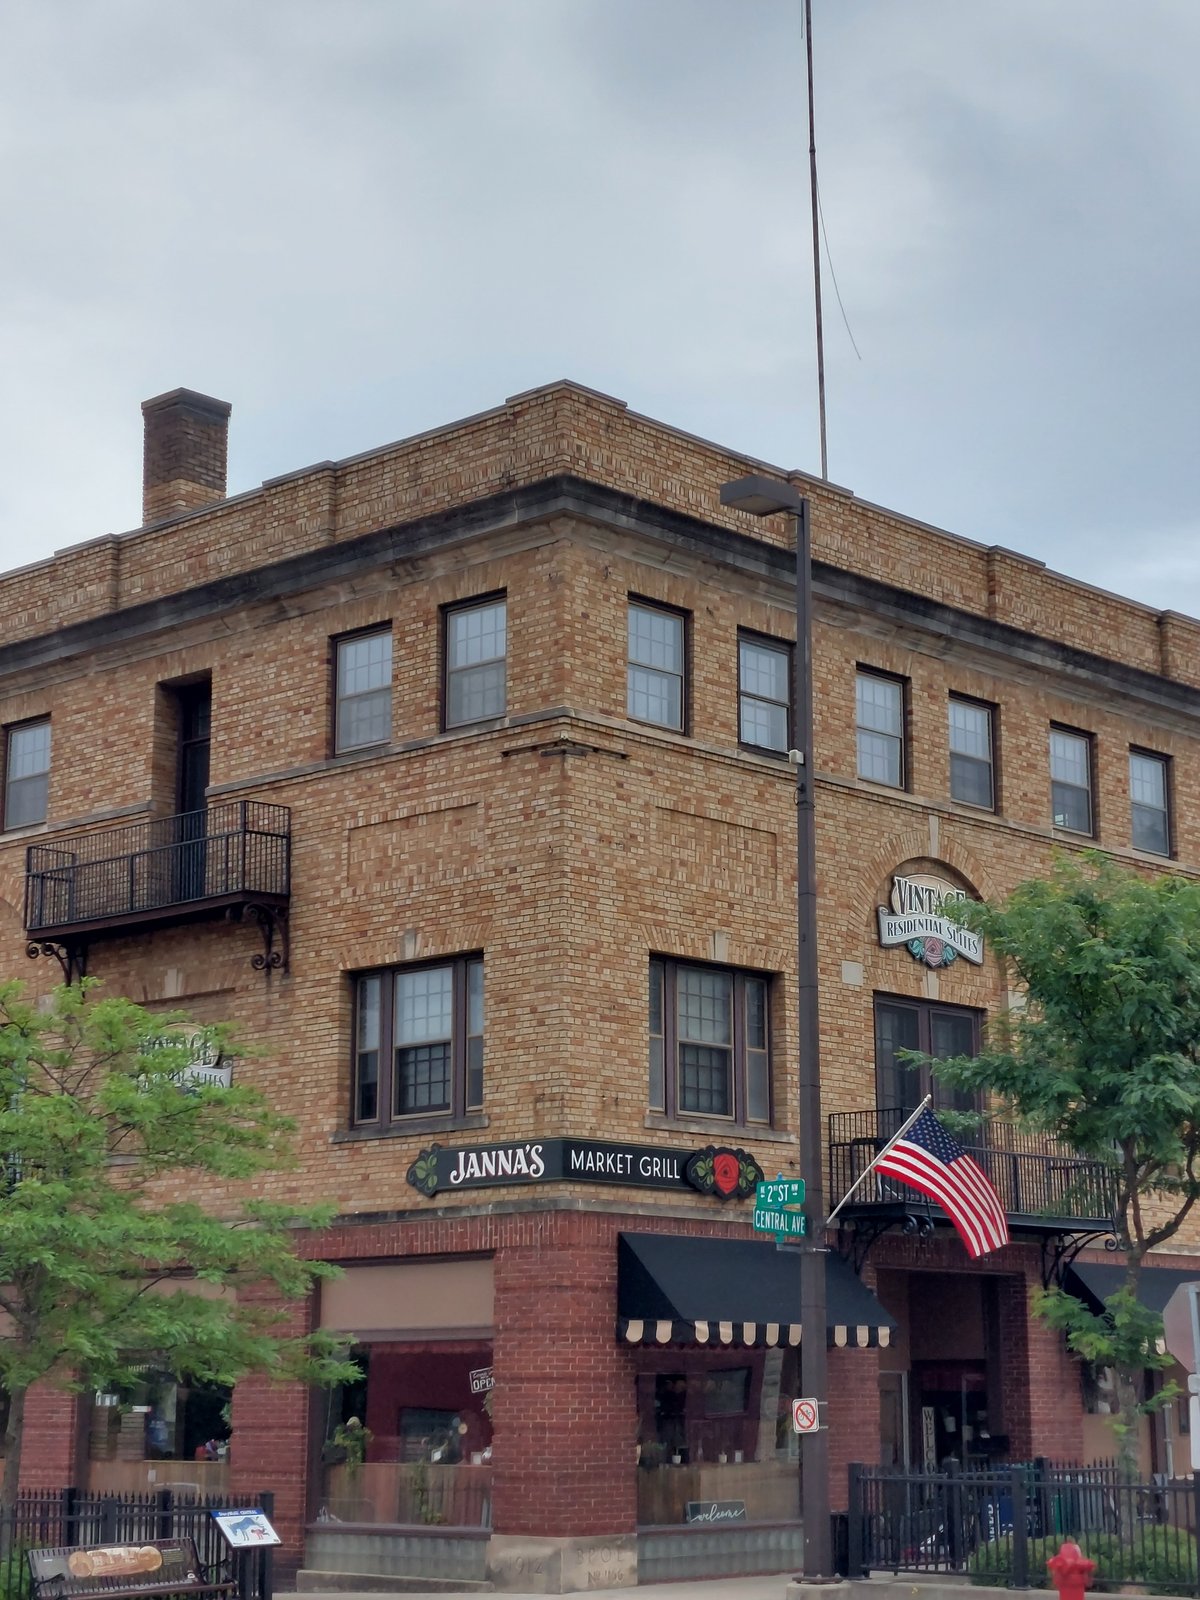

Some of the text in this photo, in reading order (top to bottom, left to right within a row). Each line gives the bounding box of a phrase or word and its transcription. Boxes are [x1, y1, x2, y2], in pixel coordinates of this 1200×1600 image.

[887, 918, 978, 955] RESIDENTIAL SUITES
[450, 1144, 545, 1184] JANNA'S
[571, 1149, 681, 1179] MARKET GRILL
[755, 1210, 805, 1234] CENTRAL AVE
